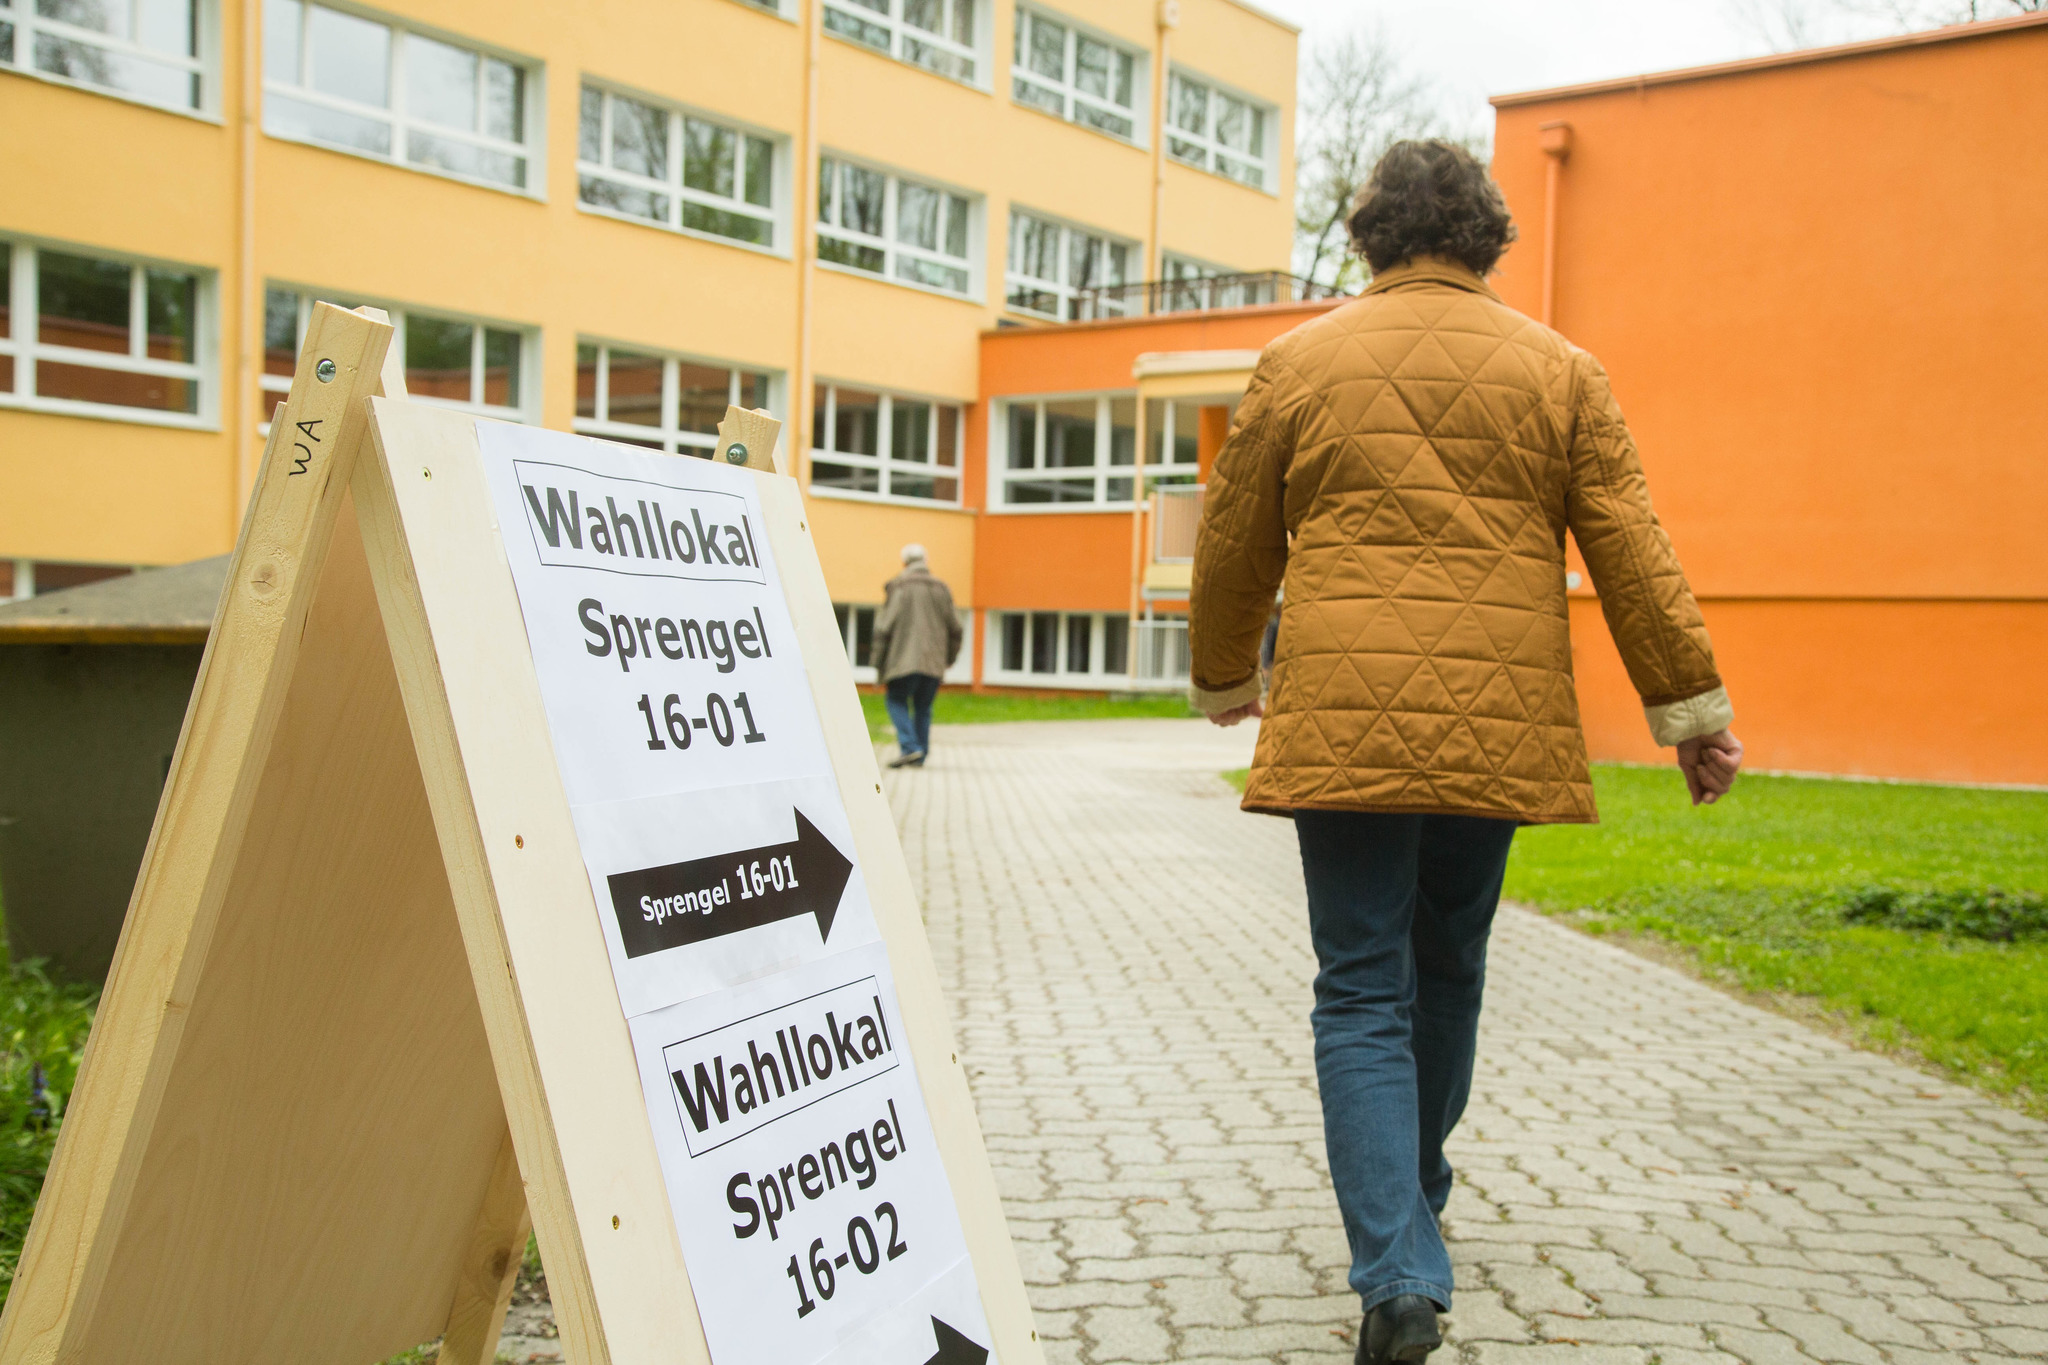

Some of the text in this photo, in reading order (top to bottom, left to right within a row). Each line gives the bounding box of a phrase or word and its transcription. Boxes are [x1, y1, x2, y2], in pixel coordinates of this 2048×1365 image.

[289, 420, 323, 476] WA
[523, 485, 760, 569] Wahllokal
[577, 598, 772, 674] Sprengel
[637, 692, 766, 751] 16-01
[639, 855, 799, 925] Sprengel 16-01
[671, 995, 892, 1134] Wahllokal
[726, 1098, 906, 1242] Sprengel
[786, 1201, 908, 1319] 16-02
